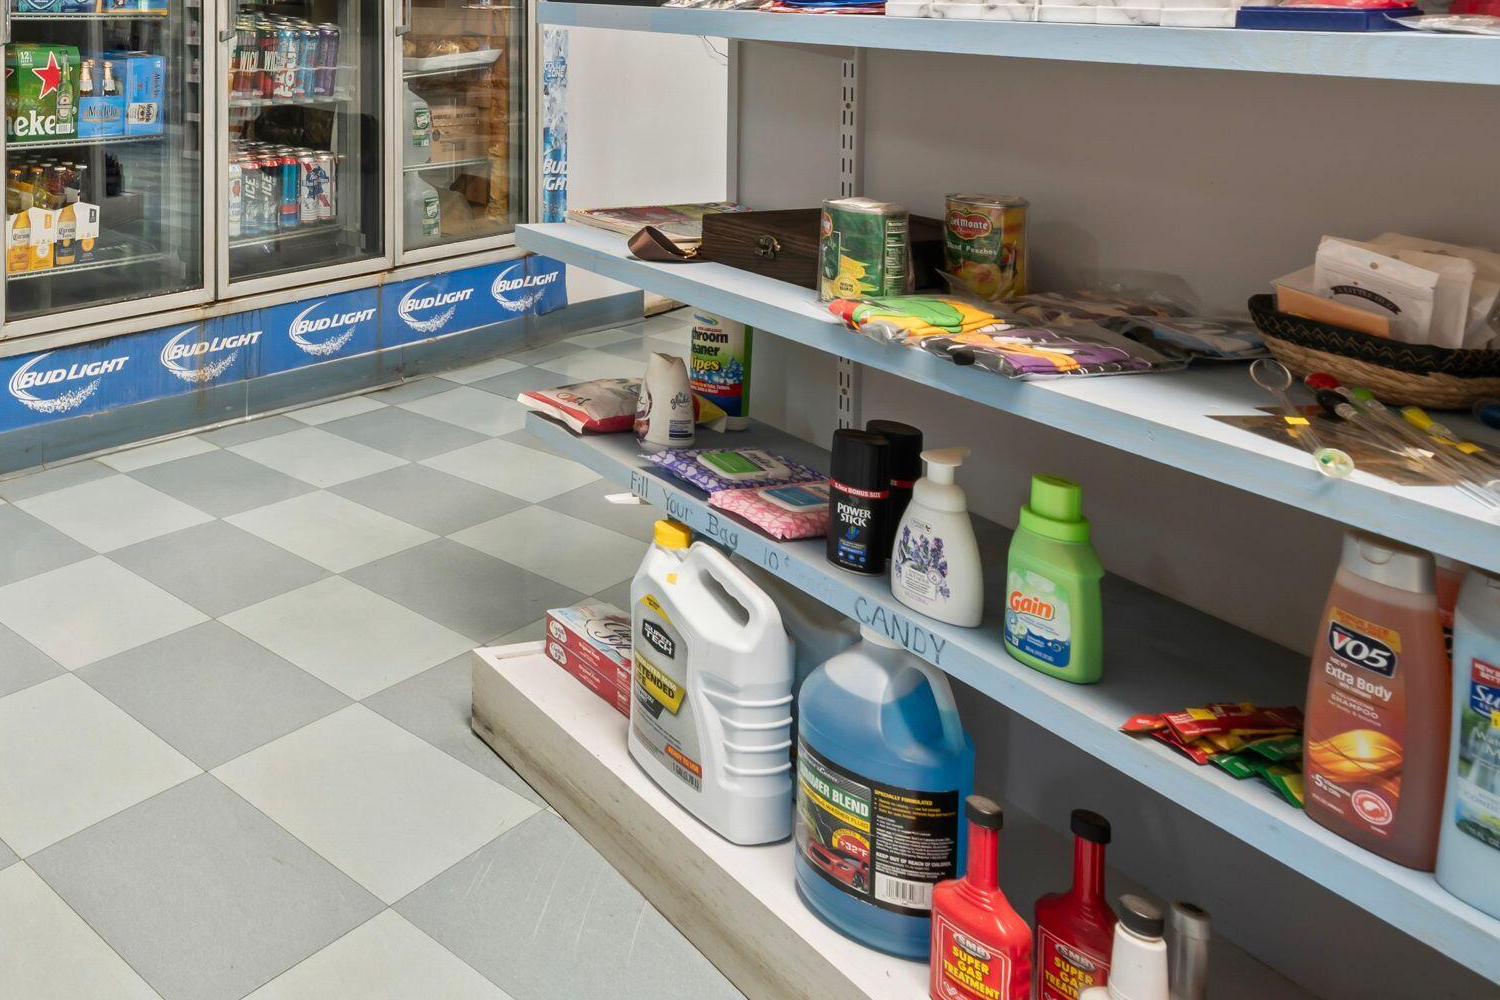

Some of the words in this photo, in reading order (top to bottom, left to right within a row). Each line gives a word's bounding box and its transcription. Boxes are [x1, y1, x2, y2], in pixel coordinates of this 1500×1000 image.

[966, 246, 997, 255] Peaches
[498, 277, 525, 292] BUD
[524, 271, 559, 288] LIGHT
[405, 296, 436, 311] BUD
[435, 288, 473, 307] LIGHT
[297, 317, 332, 334] BUD
[331, 308, 377, 329] LIGHT
[172, 341, 209, 358] BUD
[208, 330, 263, 353] LIGHT
[22, 368, 67, 386] BUD
[65, 356, 130, 380] LIGHT
[848, 488, 869, 497] BONUS
[630, 470, 650, 499] Fill
[663, 491, 693, 524] Your
[706, 512, 739, 550] Bag
[837, 502, 871, 519] POWER
[840, 513, 866, 527] STICK
[1009, 591, 1055, 620] Gain
[644, 623, 671, 645] SUPER
[645, 632, 672, 655] TECH
[854, 597, 946, 665] CANDY
[1333, 630, 1391, 668] VO5
[1330, 657, 1348, 669] NEW
[1325, 663, 1355, 685] Extra
[1357, 678, 1392, 701] Body
[1330, 694, 1378, 720] SHAMPOO
[832, 790, 868, 817] BLEND
[952, 946, 990, 974] SUPER
[958, 961, 983, 981] GAS
[943, 960, 1000, 999] TREATMENT
